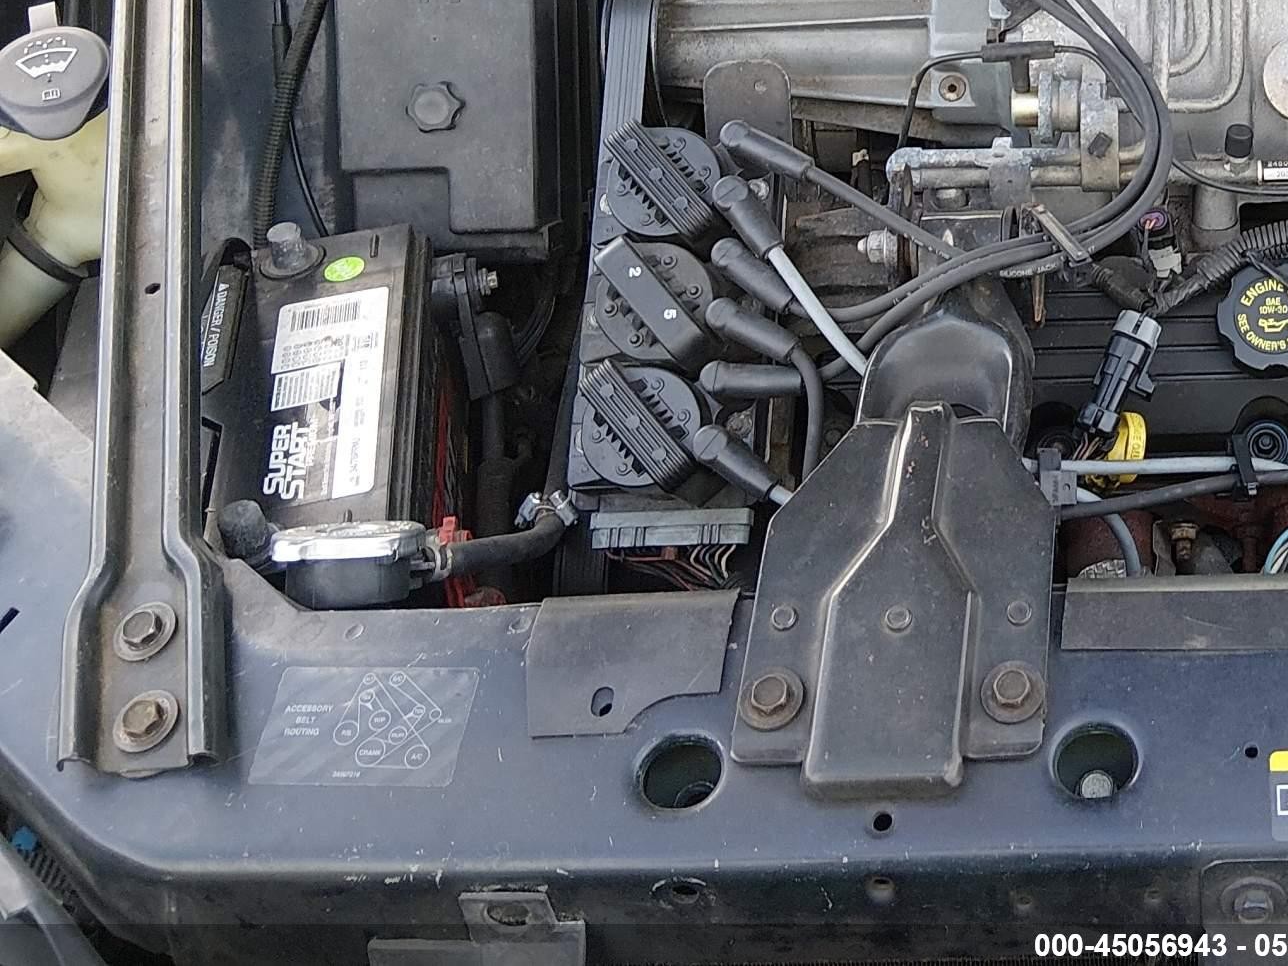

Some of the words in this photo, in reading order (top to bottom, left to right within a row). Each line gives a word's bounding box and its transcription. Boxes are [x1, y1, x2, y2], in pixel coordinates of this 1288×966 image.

[629, 267, 642, 277] 2
[210, 290, 228, 327] DANGER
[1259, 304, 1288, 314] 10W-30
[664, 309, 677, 320] 5
[1237, 313, 1251, 333] SEE
[1246, 331, 1287, 351] OWNER'S
[203, 333, 220, 368] POISON
[262, 423, 292, 495] SUPER
[281, 421, 311, 500] START
[284, 704, 333, 714] ACCESSORY
[296, 716, 317, 724] BELT
[284, 727, 319, 736] ROUTING
